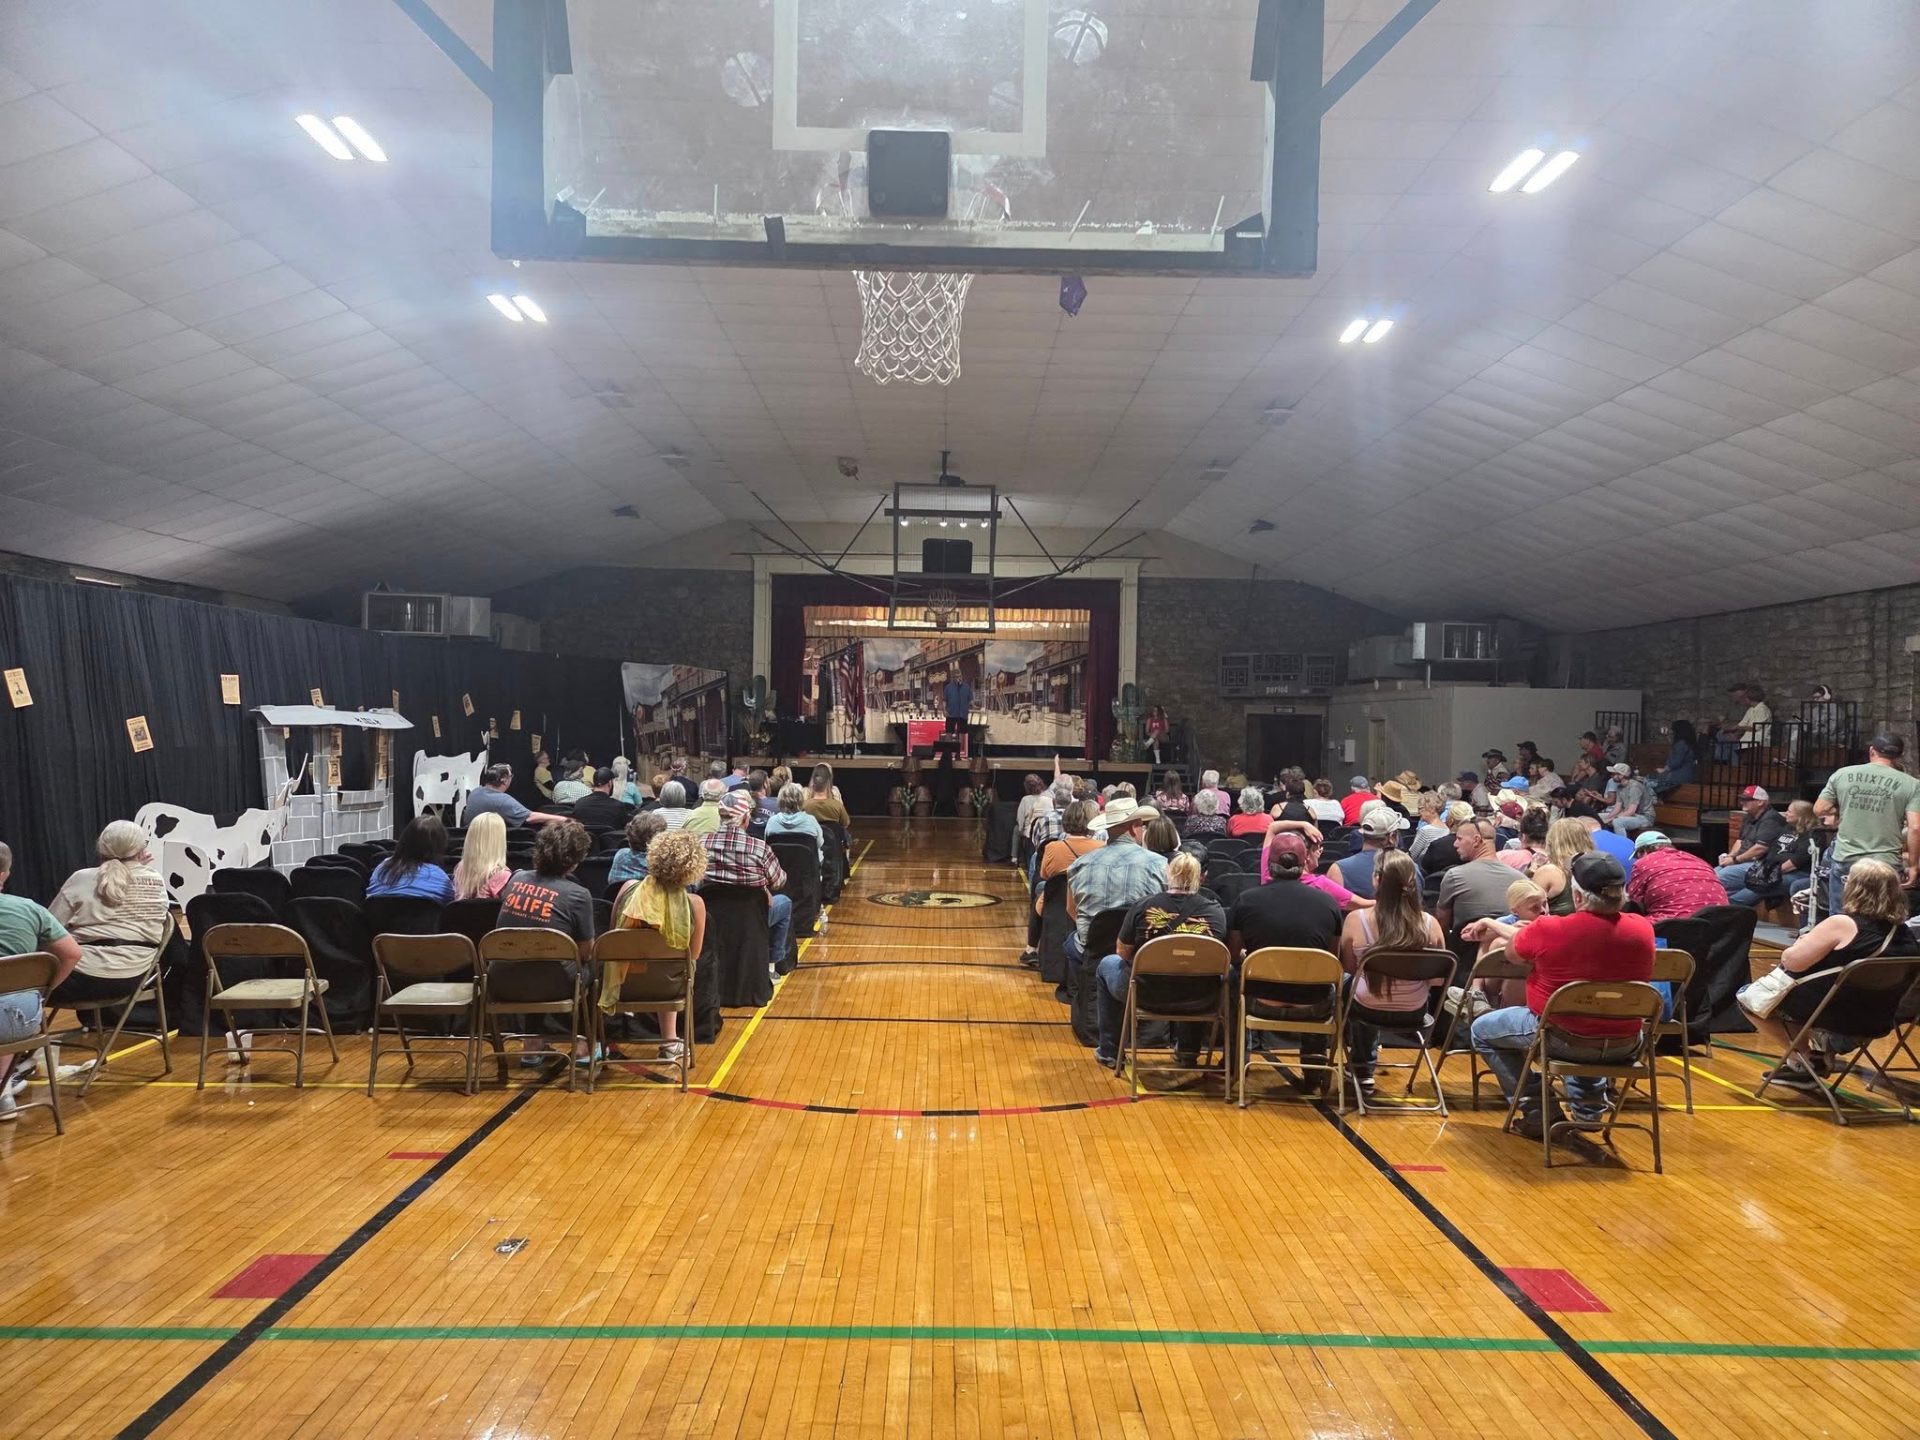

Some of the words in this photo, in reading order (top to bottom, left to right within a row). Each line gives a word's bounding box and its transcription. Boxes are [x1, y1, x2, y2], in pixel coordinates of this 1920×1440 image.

[1848, 773, 1902, 791] BRIXTON
[1849, 785, 1892, 800] Quality
[1848, 801, 1886, 814] COMPANY
[511, 882, 560, 902] THRIFT
